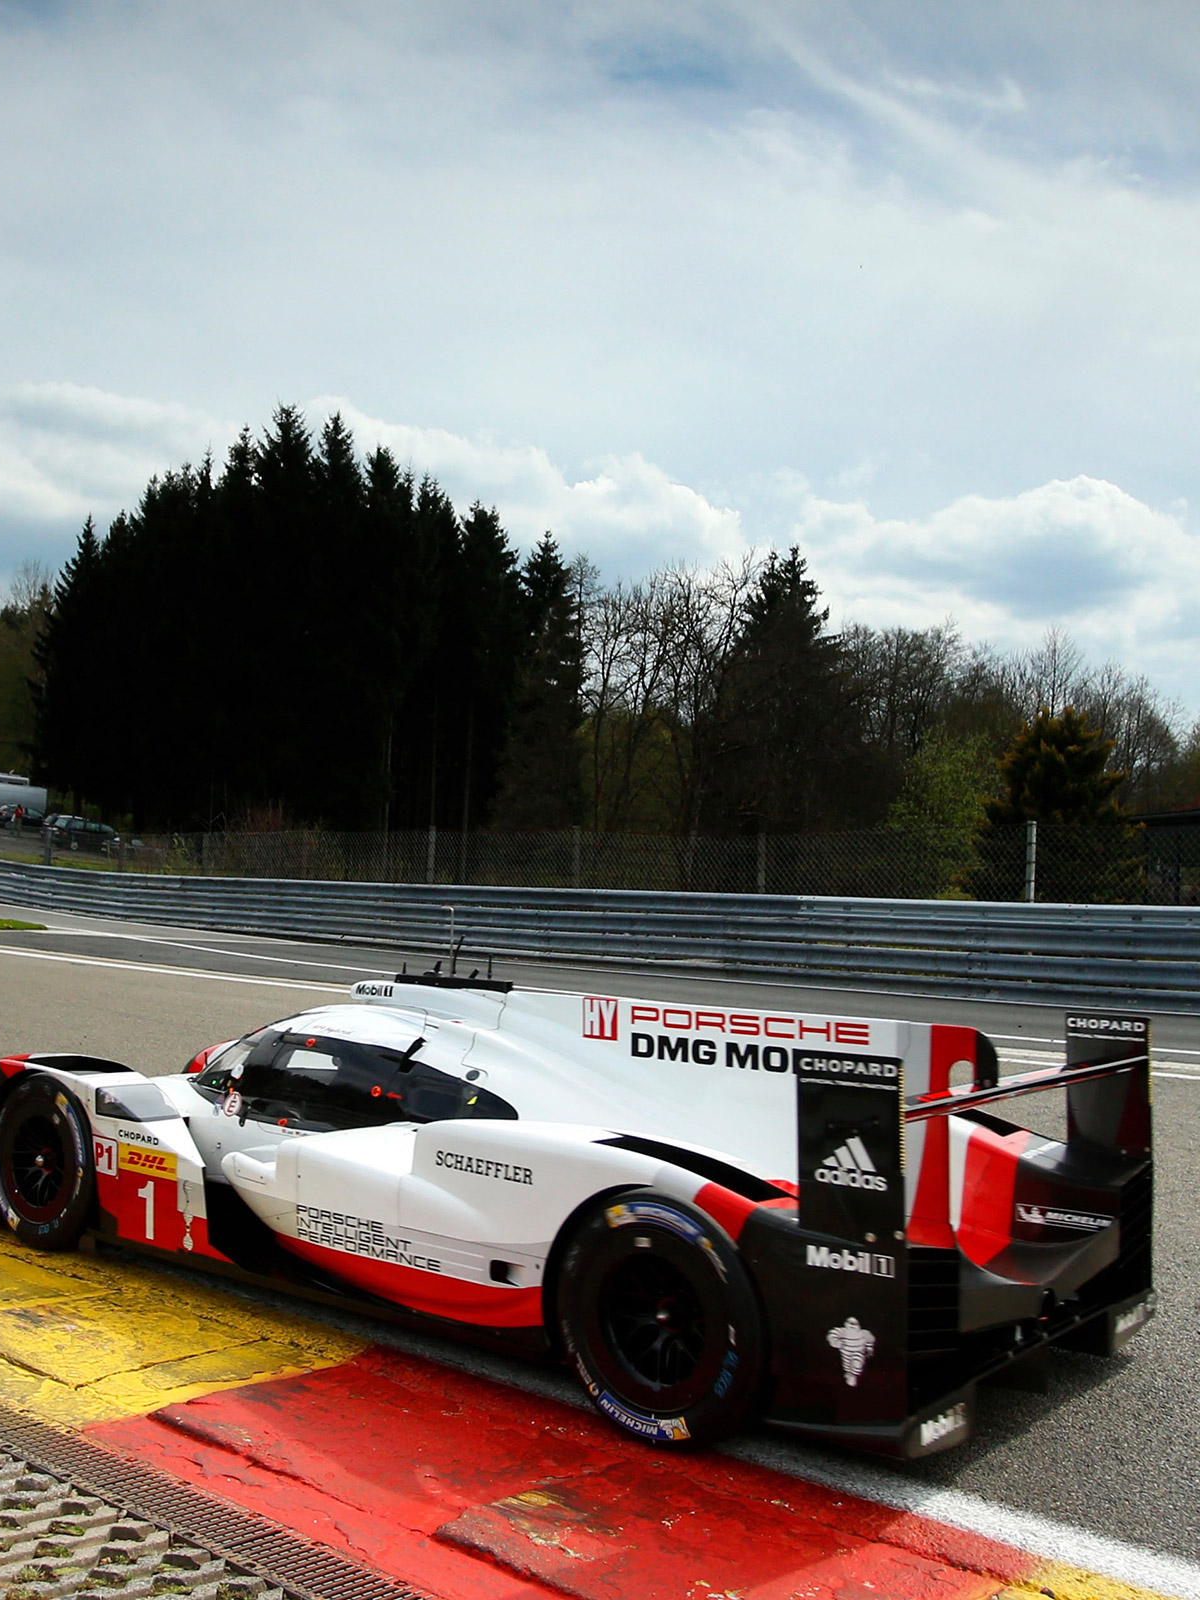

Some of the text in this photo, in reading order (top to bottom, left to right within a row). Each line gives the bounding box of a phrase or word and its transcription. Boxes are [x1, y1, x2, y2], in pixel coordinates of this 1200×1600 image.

[356, 984, 383, 997] Mobil
[631, 1006, 870, 1045] PORSCHE
[1067, 1017, 1146, 1032] CHOPARD
[631, 1033, 798, 1075] DMG MO
[799, 1057, 899, 1078] CHOPARD
[118, 1129, 160, 1146] CHOPARD
[127, 1150, 169, 1172] DHL
[435, 1150, 533, 1185] SCHAEFFLER
[814, 1167, 888, 1192] adidas
[137, 1180, 155, 1241] 1
[296, 1204, 384, 1233] PORSCHE
[297, 1216, 411, 1252] INTELLIGENT
[297, 1228, 441, 1273] PERFORMANCE
[806, 1245, 871, 1275] Mobil
[600, 1399, 659, 1436] MICHELIN
